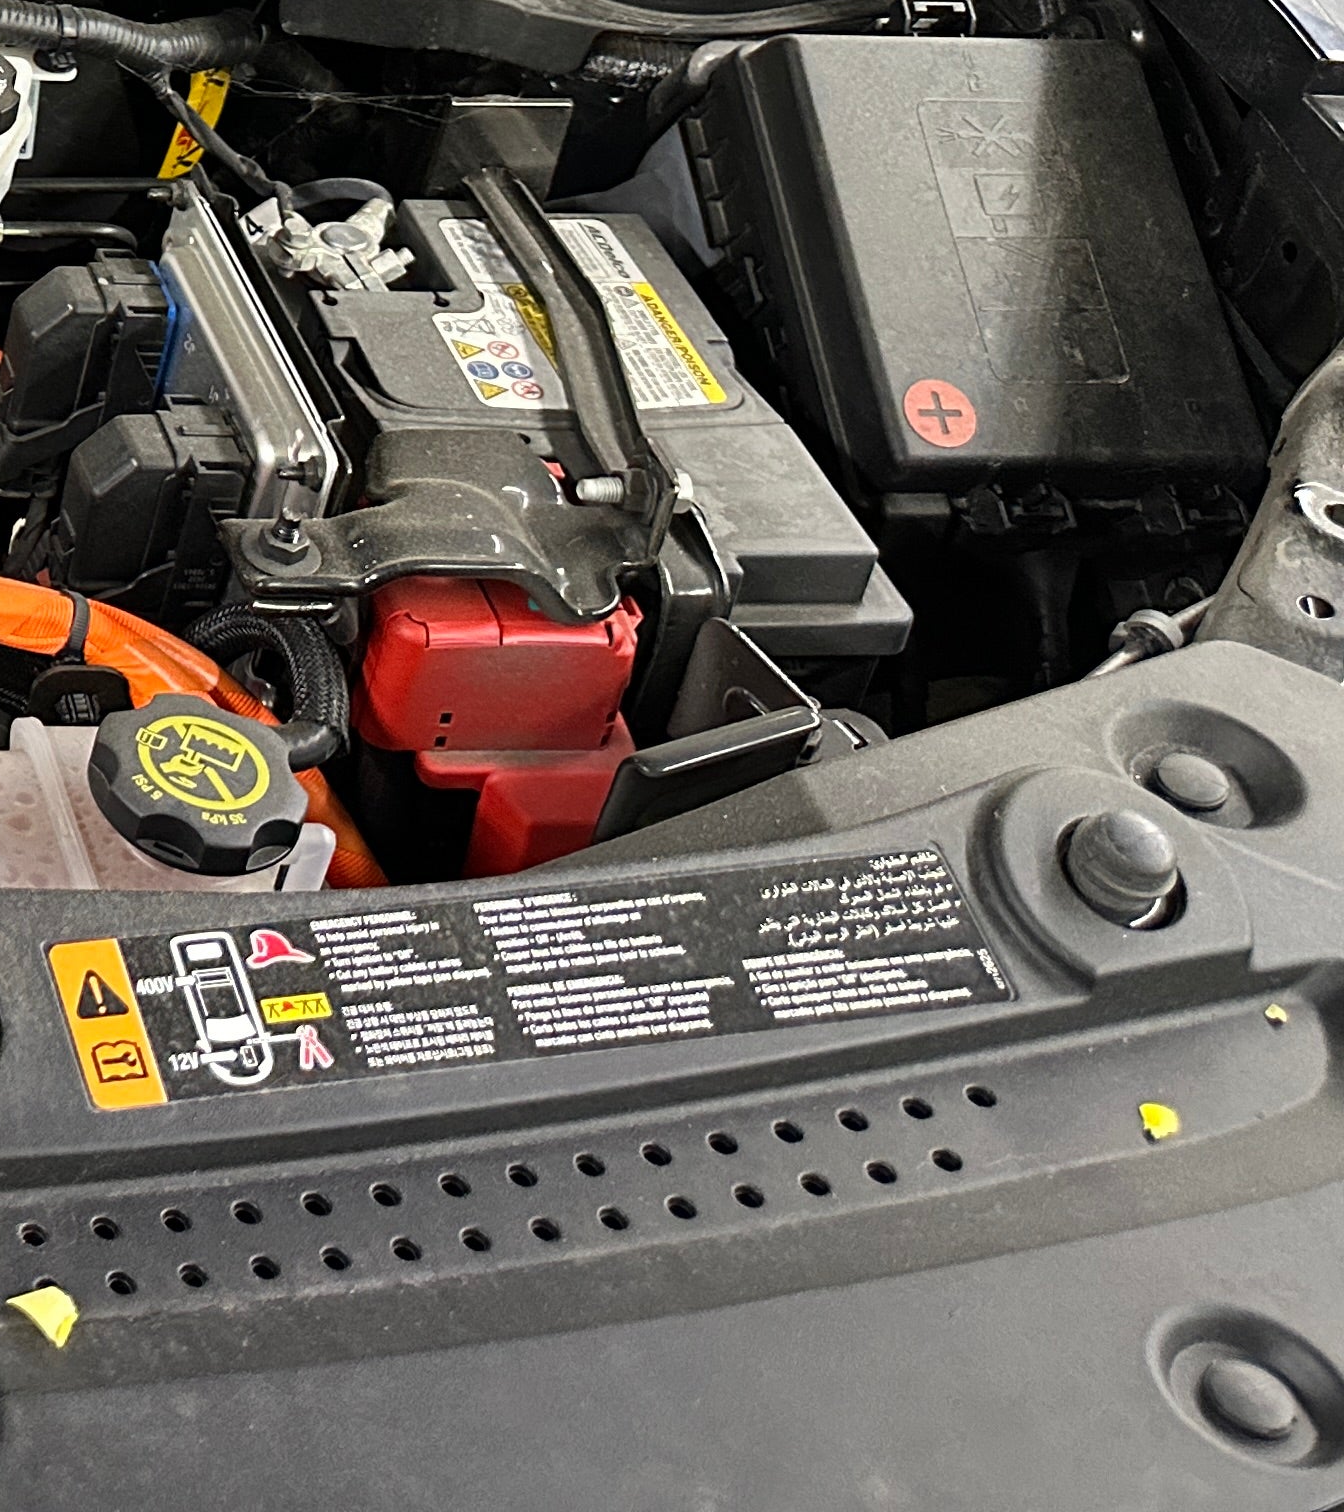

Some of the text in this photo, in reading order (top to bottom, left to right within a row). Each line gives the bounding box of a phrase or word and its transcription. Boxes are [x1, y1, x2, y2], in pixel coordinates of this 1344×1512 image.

[245, 215, 264, 236] 4
[584, 222, 632, 279] ACDelco
[131, 773, 154, 793] PSI
[200, 811, 247, 825] 35 kPa
[331, 957, 351, 966] Turn
[136, 975, 175, 996] 400V
[168, 1052, 199, 1071] 12V
